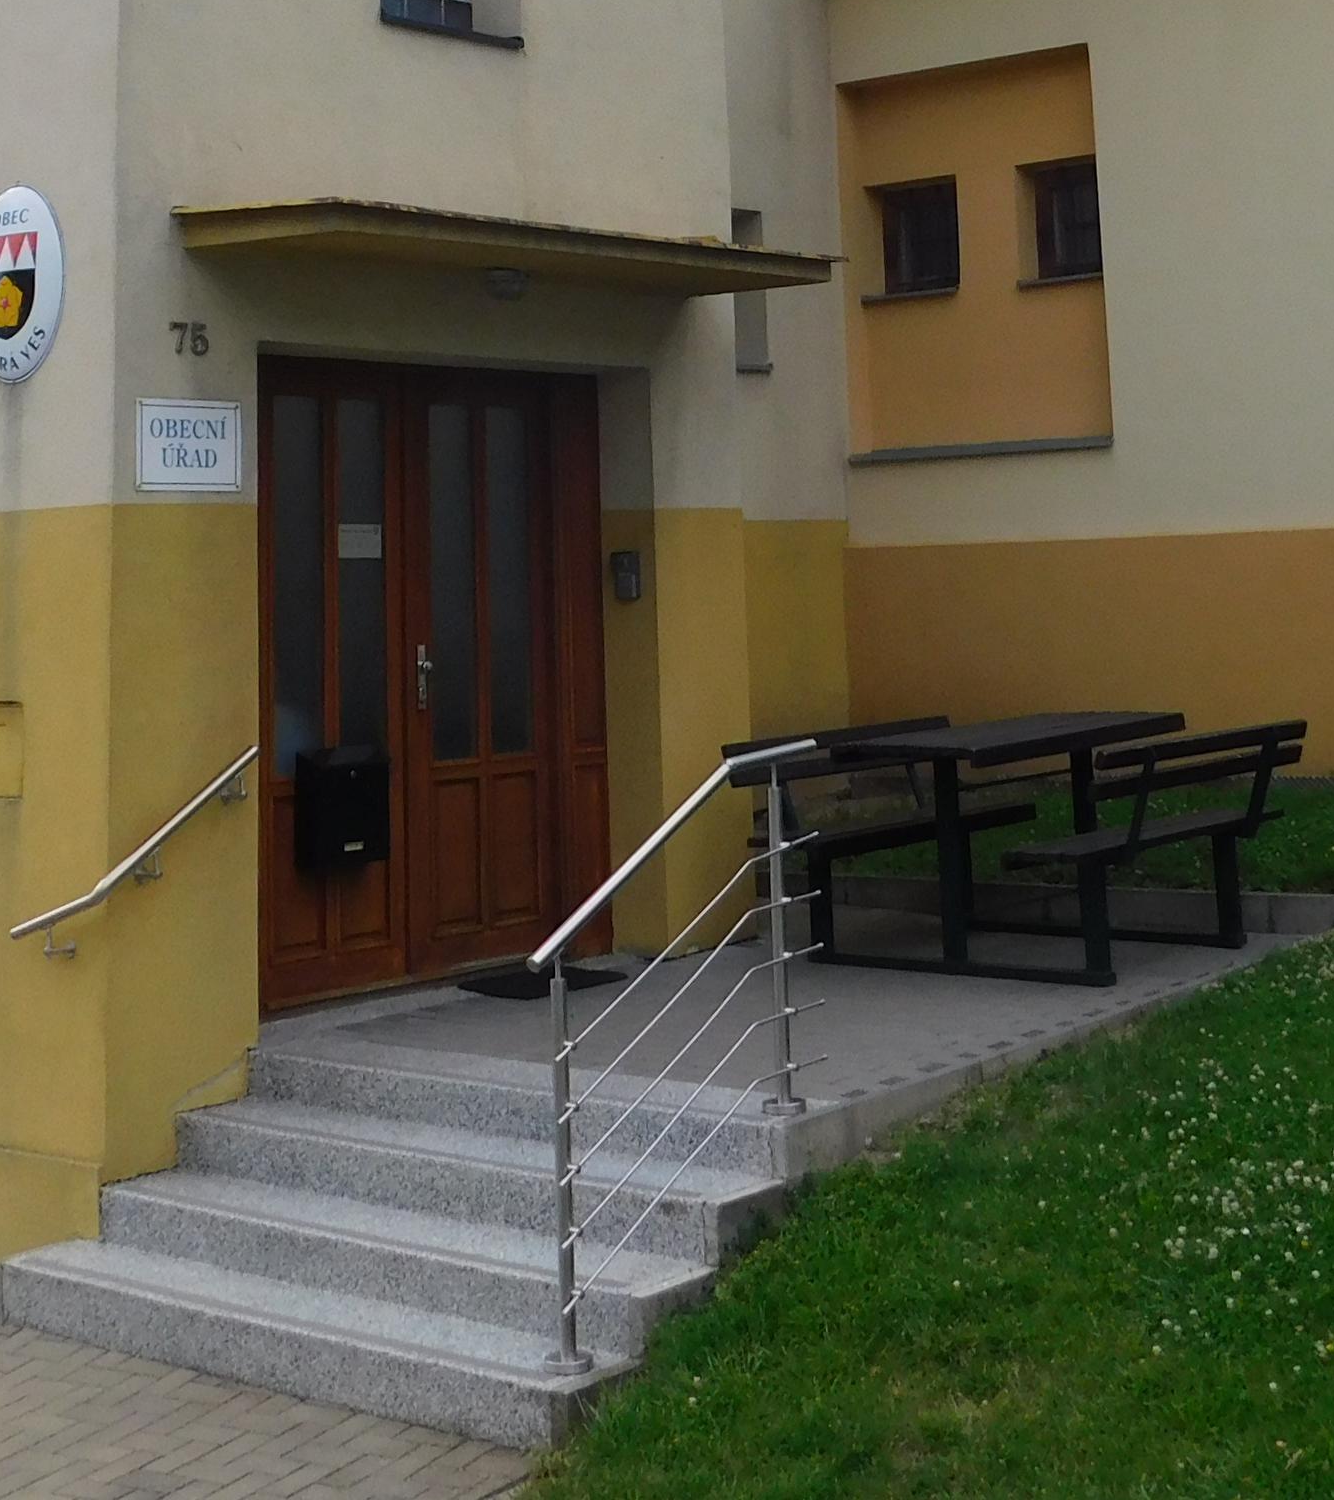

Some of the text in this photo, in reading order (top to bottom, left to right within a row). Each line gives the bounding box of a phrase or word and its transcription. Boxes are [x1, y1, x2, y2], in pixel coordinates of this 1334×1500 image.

[20, 326, 46, 361] VES
[169, 322, 209, 356] 75
[150, 416, 227, 440] OBECNÍ
[162, 443, 217, 469] ÚŘAD
